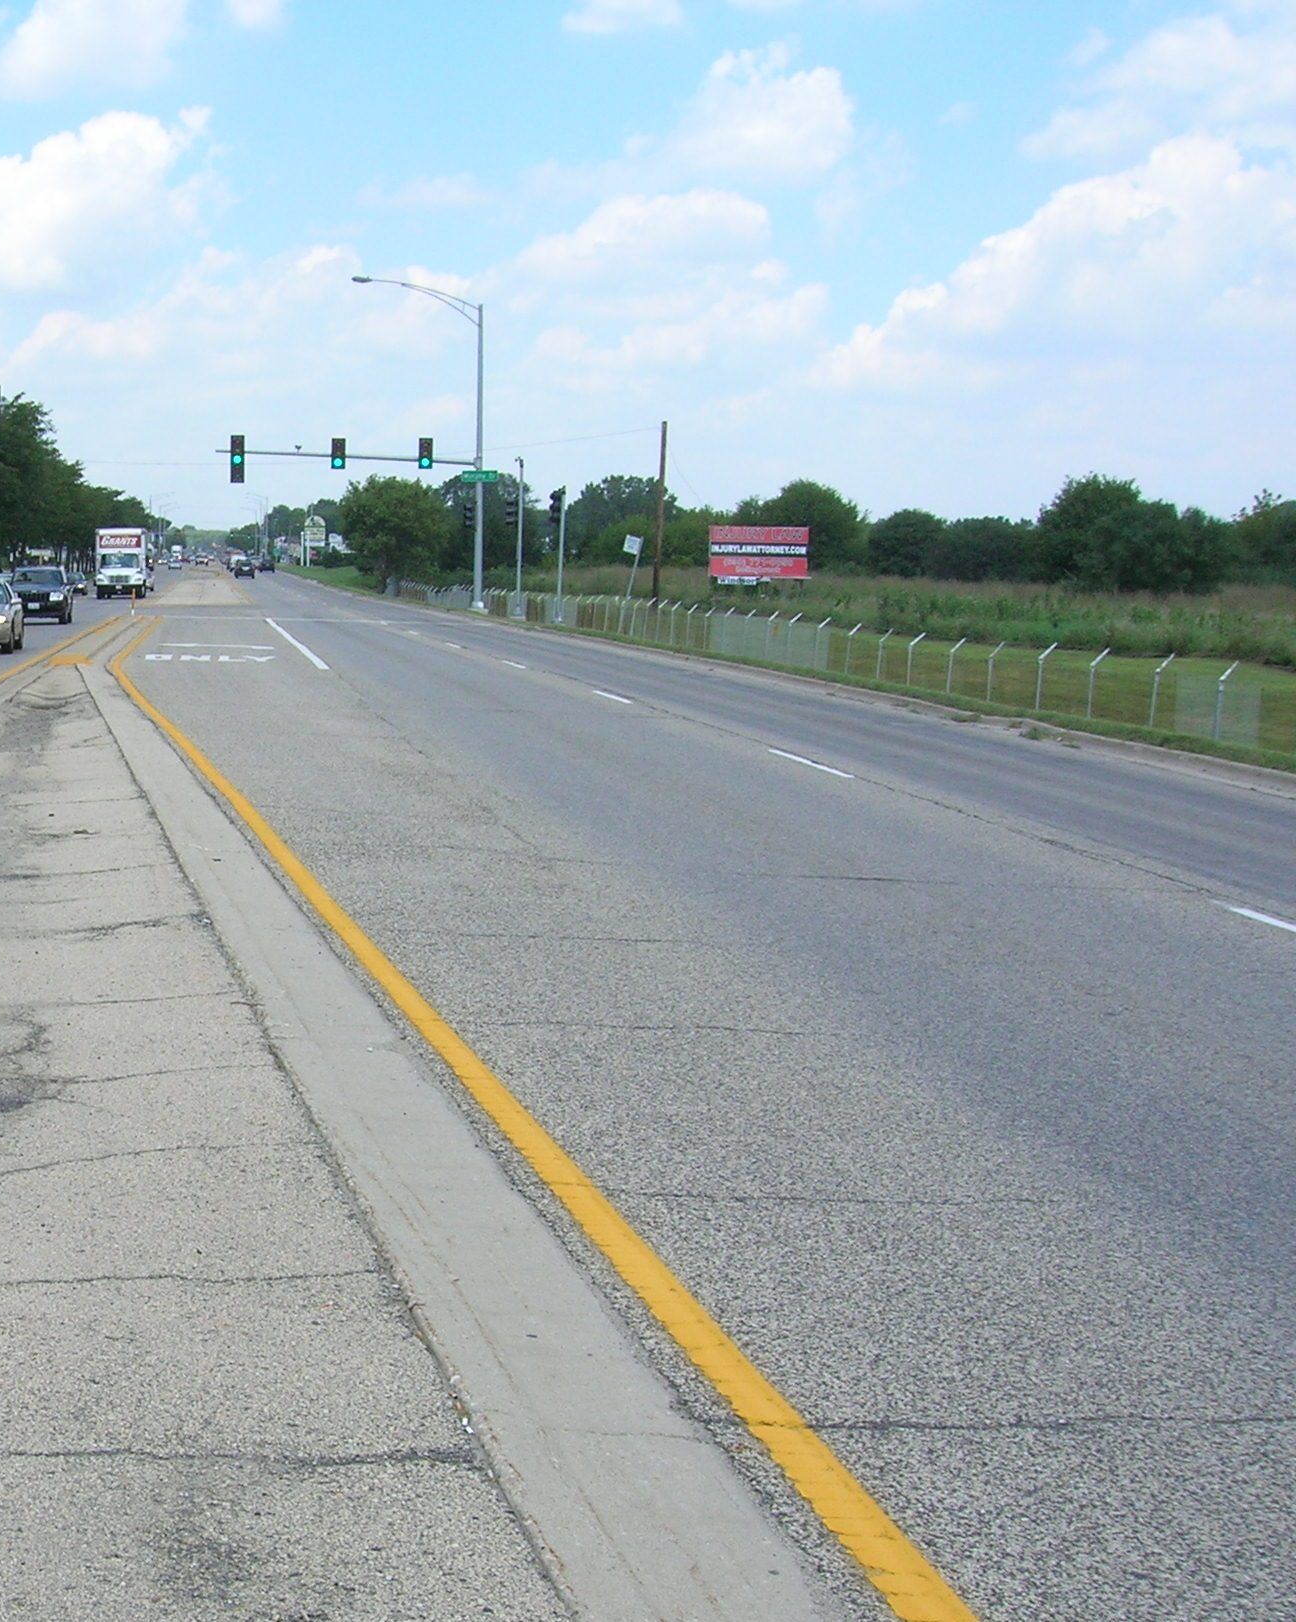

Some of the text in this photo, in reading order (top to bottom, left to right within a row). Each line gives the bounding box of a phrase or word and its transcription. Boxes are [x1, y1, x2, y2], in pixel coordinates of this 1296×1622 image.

[771, 527, 804, 541] LAW
[711, 545, 806, 555] INJURYLAWATTORNEY.COM
[721, 576, 756, 584] Windsor
[144, 654, 276, 662] ONLY
